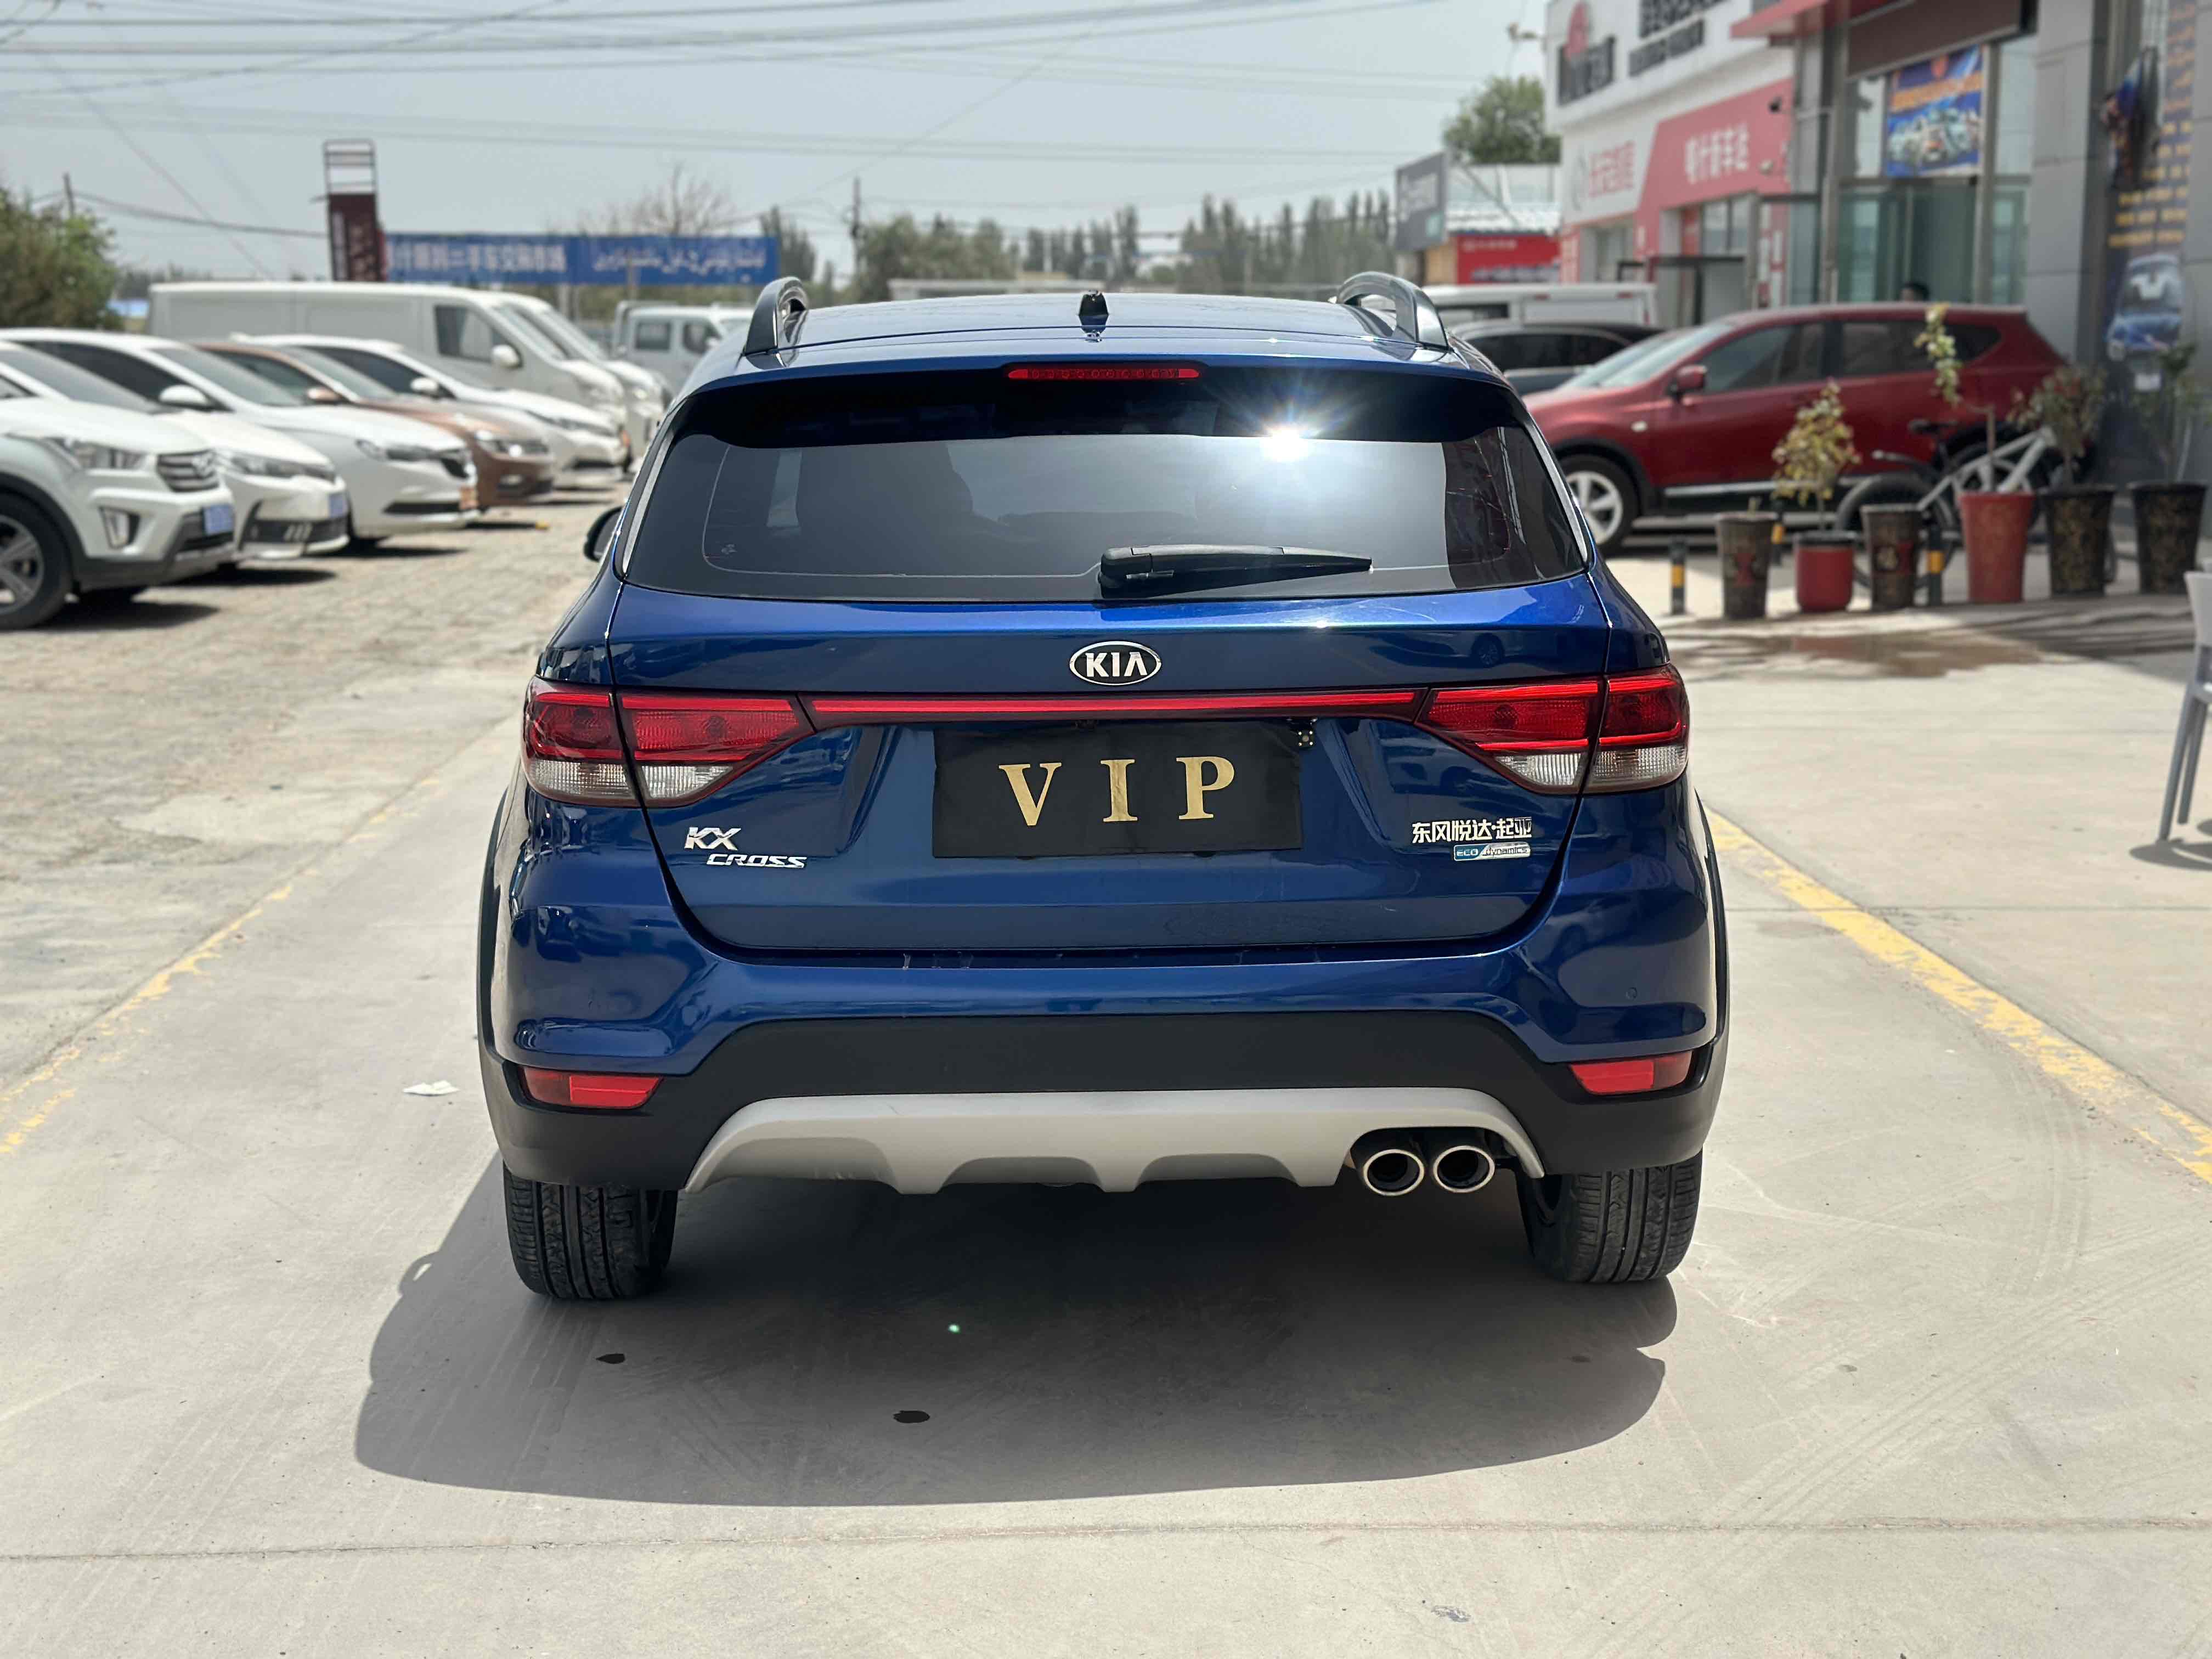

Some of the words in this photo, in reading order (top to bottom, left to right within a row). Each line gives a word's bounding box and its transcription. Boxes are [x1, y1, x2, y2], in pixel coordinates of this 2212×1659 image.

[1085, 651, 1148, 678] KIA
[998, 756, 1235, 827] VIP
[684, 826, 742, 851] KX
[706, 853, 808, 868] CROSS
